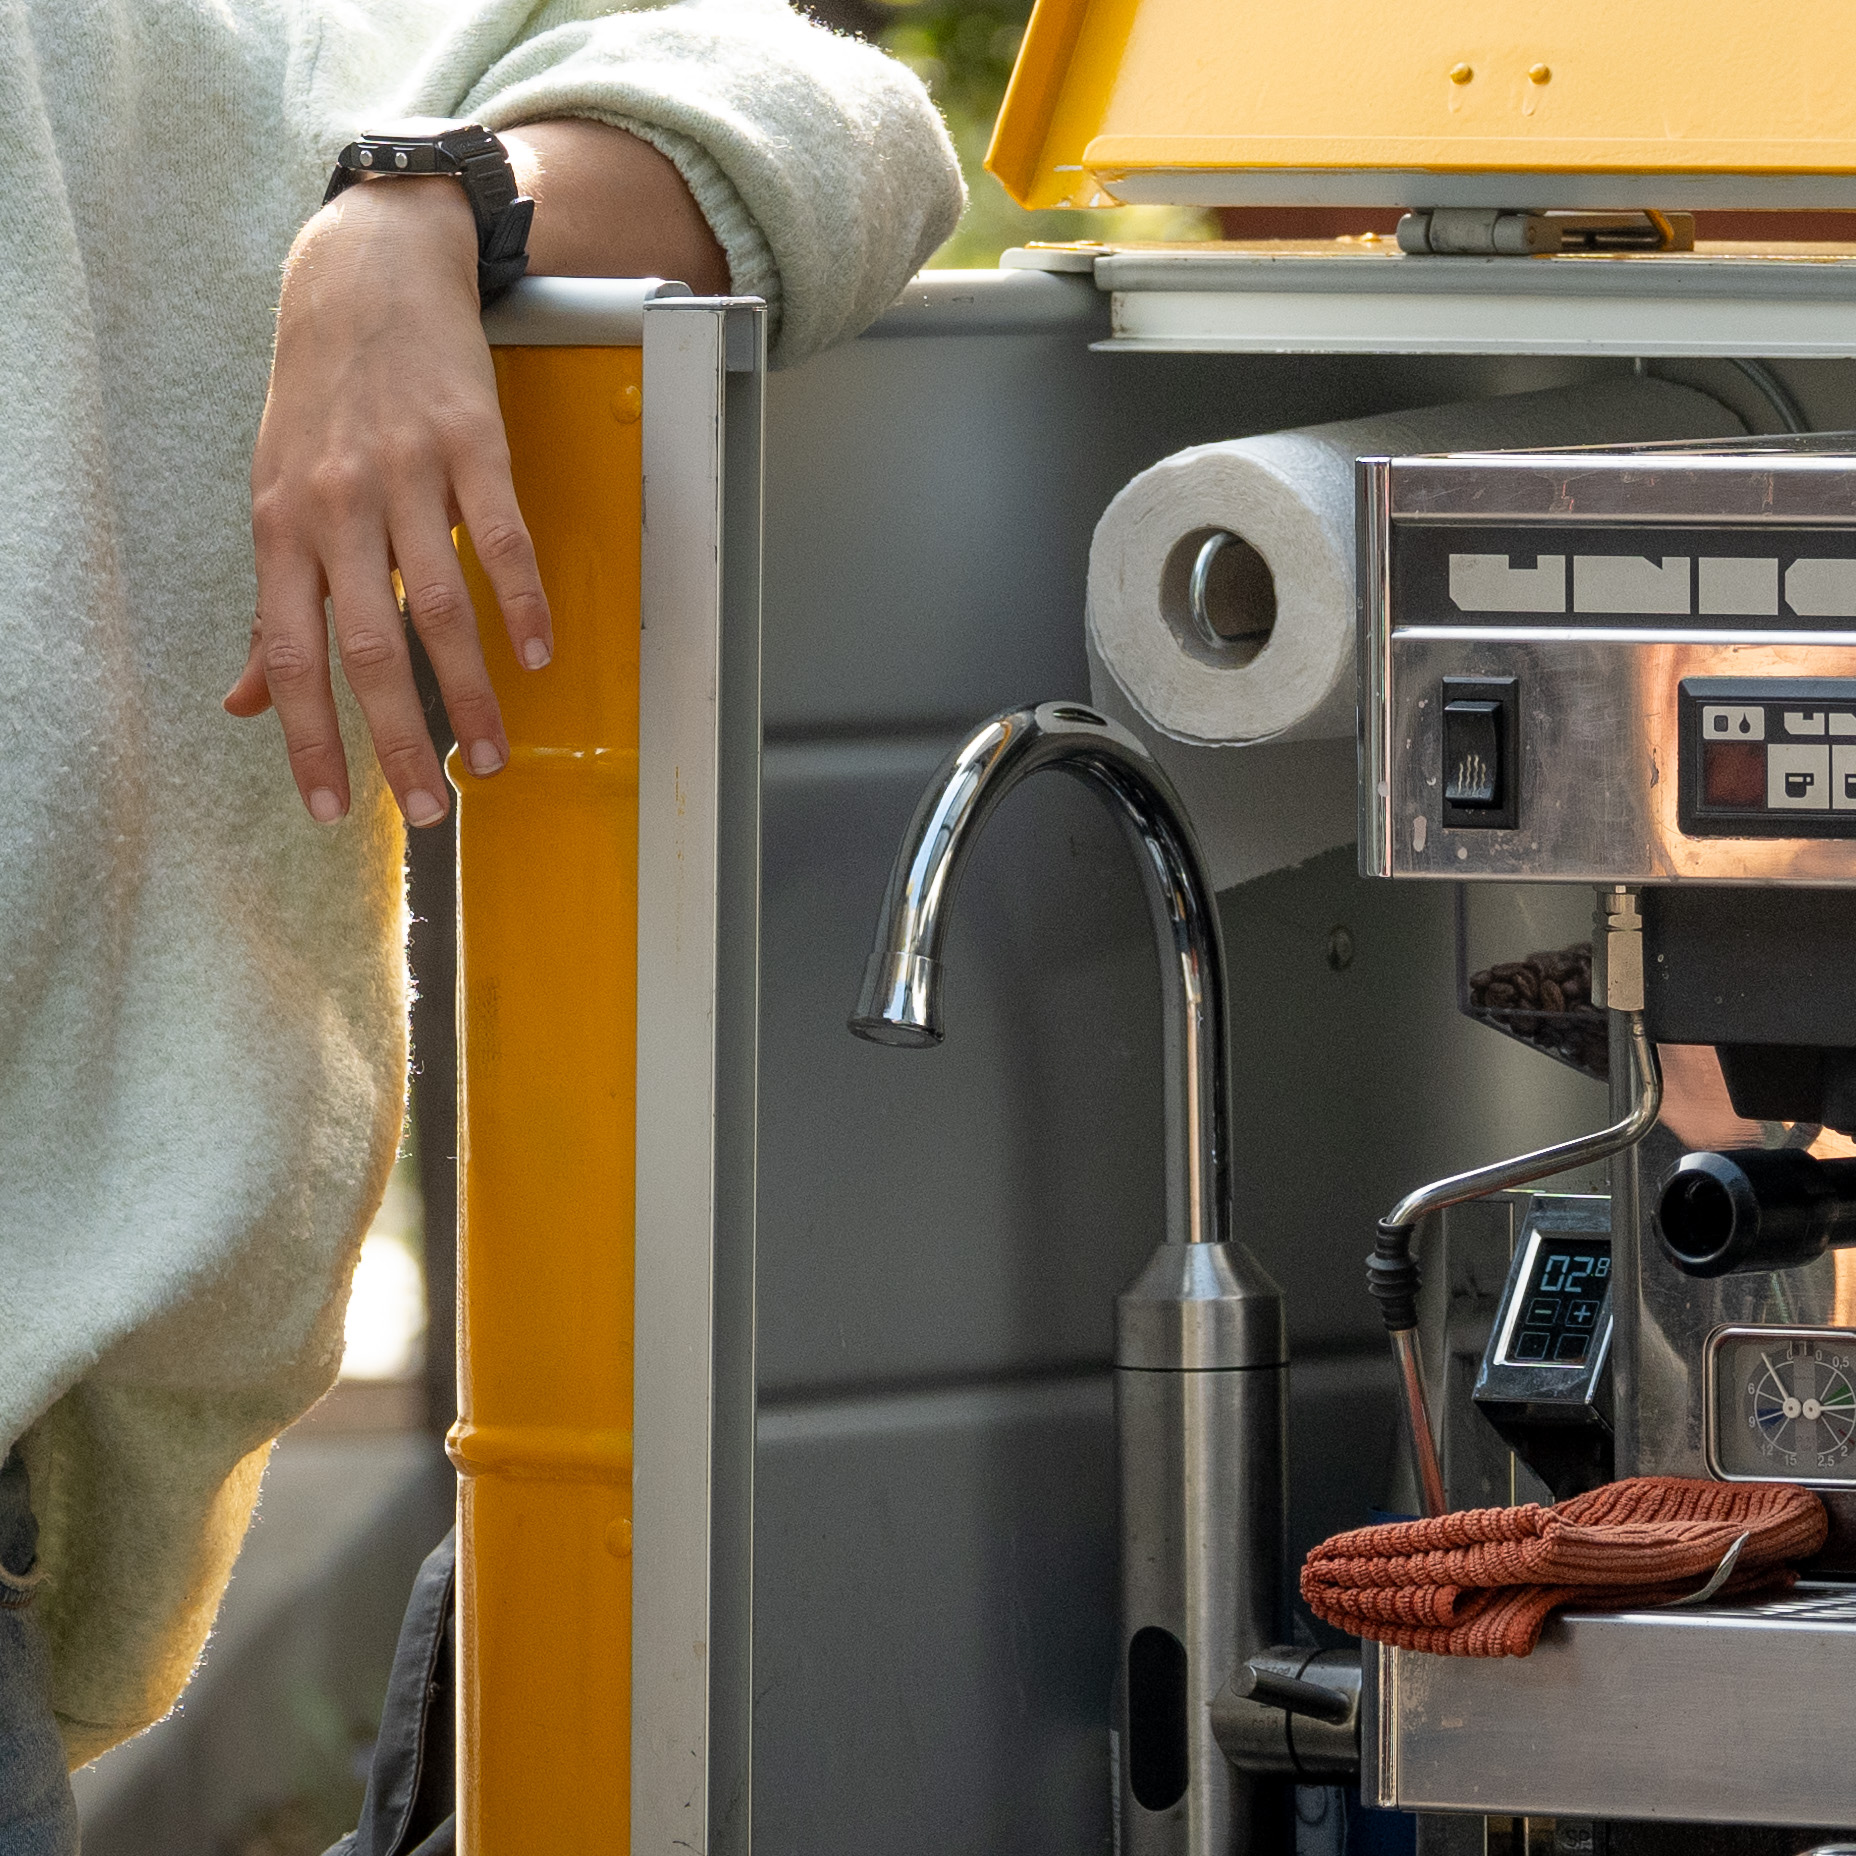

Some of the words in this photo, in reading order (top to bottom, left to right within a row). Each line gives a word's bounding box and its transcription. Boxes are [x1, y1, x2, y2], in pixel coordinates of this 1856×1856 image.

[1832, 1356, 1850, 1370] 0,5
[1747, 1383, 1755, 1394] 6
[1748, 1416, 1756, 1428] 9
[1840, 1445, 1848, 1457] 2
[1785, 1454, 1797, 1466] 15
[1817, 1456, 1835, 1469] 2,5
